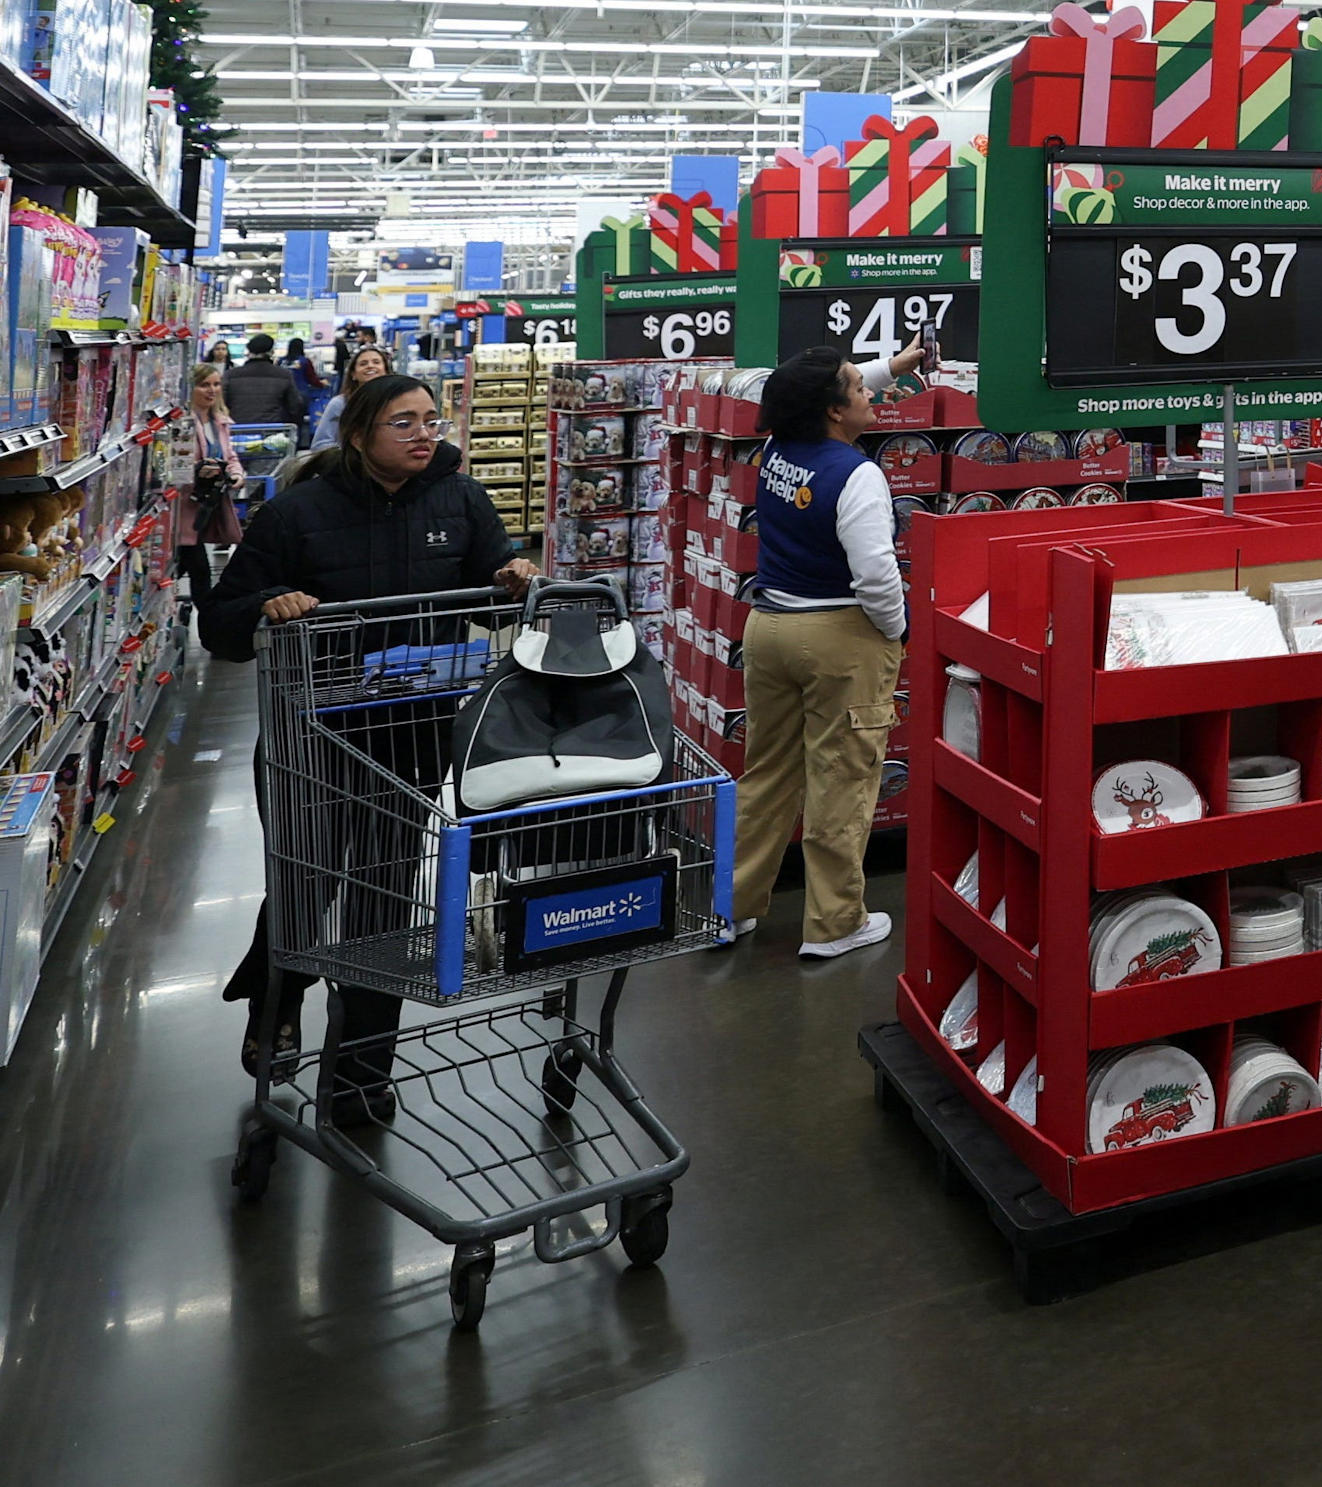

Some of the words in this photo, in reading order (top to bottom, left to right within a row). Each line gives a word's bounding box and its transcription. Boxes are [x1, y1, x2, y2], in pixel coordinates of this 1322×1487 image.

[1165, 174, 1210, 191] Make
[1213, 174, 1226, 191] it
[1229, 177, 1281, 194] merry
[1133, 196, 1166, 211] Shop
[1168, 196, 1204, 210] decor
[1206, 197, 1215, 209] &
[1217, 199, 1248, 209] more
[1251, 197, 1261, 209] in
[1263, 197, 1282, 210] the
[1284, 199, 1310, 212] app.
[846, 253, 882, 267] Make
[886, 252, 896, 266] it
[898, 253, 943, 269] merry
[861, 269, 879, 278] Shop
[898, 268, 905, 276] in
[906, 268, 919, 276] the
[920, 269, 938, 278] app.
[619, 289, 643, 300] Gifts
[645, 287, 666, 300] they
[668, 285, 697, 299] really,
[699, 283, 723, 296] really
[531, 302, 550, 311] Tasty
[1077, 395, 1118, 414] Shop
[1120, 394, 1164, 410] more
[1167, 392, 1200, 409] toys
[1202, 392, 1214, 407] &
[1251, 389, 1262, 404] in
[1264, 389, 1292, 404] the
[877, 416, 902, 424] Cookies
[767, 452, 816, 486] Happy
[760, 467, 768, 479] to
[766, 472, 798, 503] Help
[889, 482, 913, 490] Cookies
[543, 900, 616, 928] Walmart
[544, 928, 558, 937] Save
[559, 924, 581, 934] money.
[582, 921, 594, 929] Live
[595, 918, 616, 926] better.
